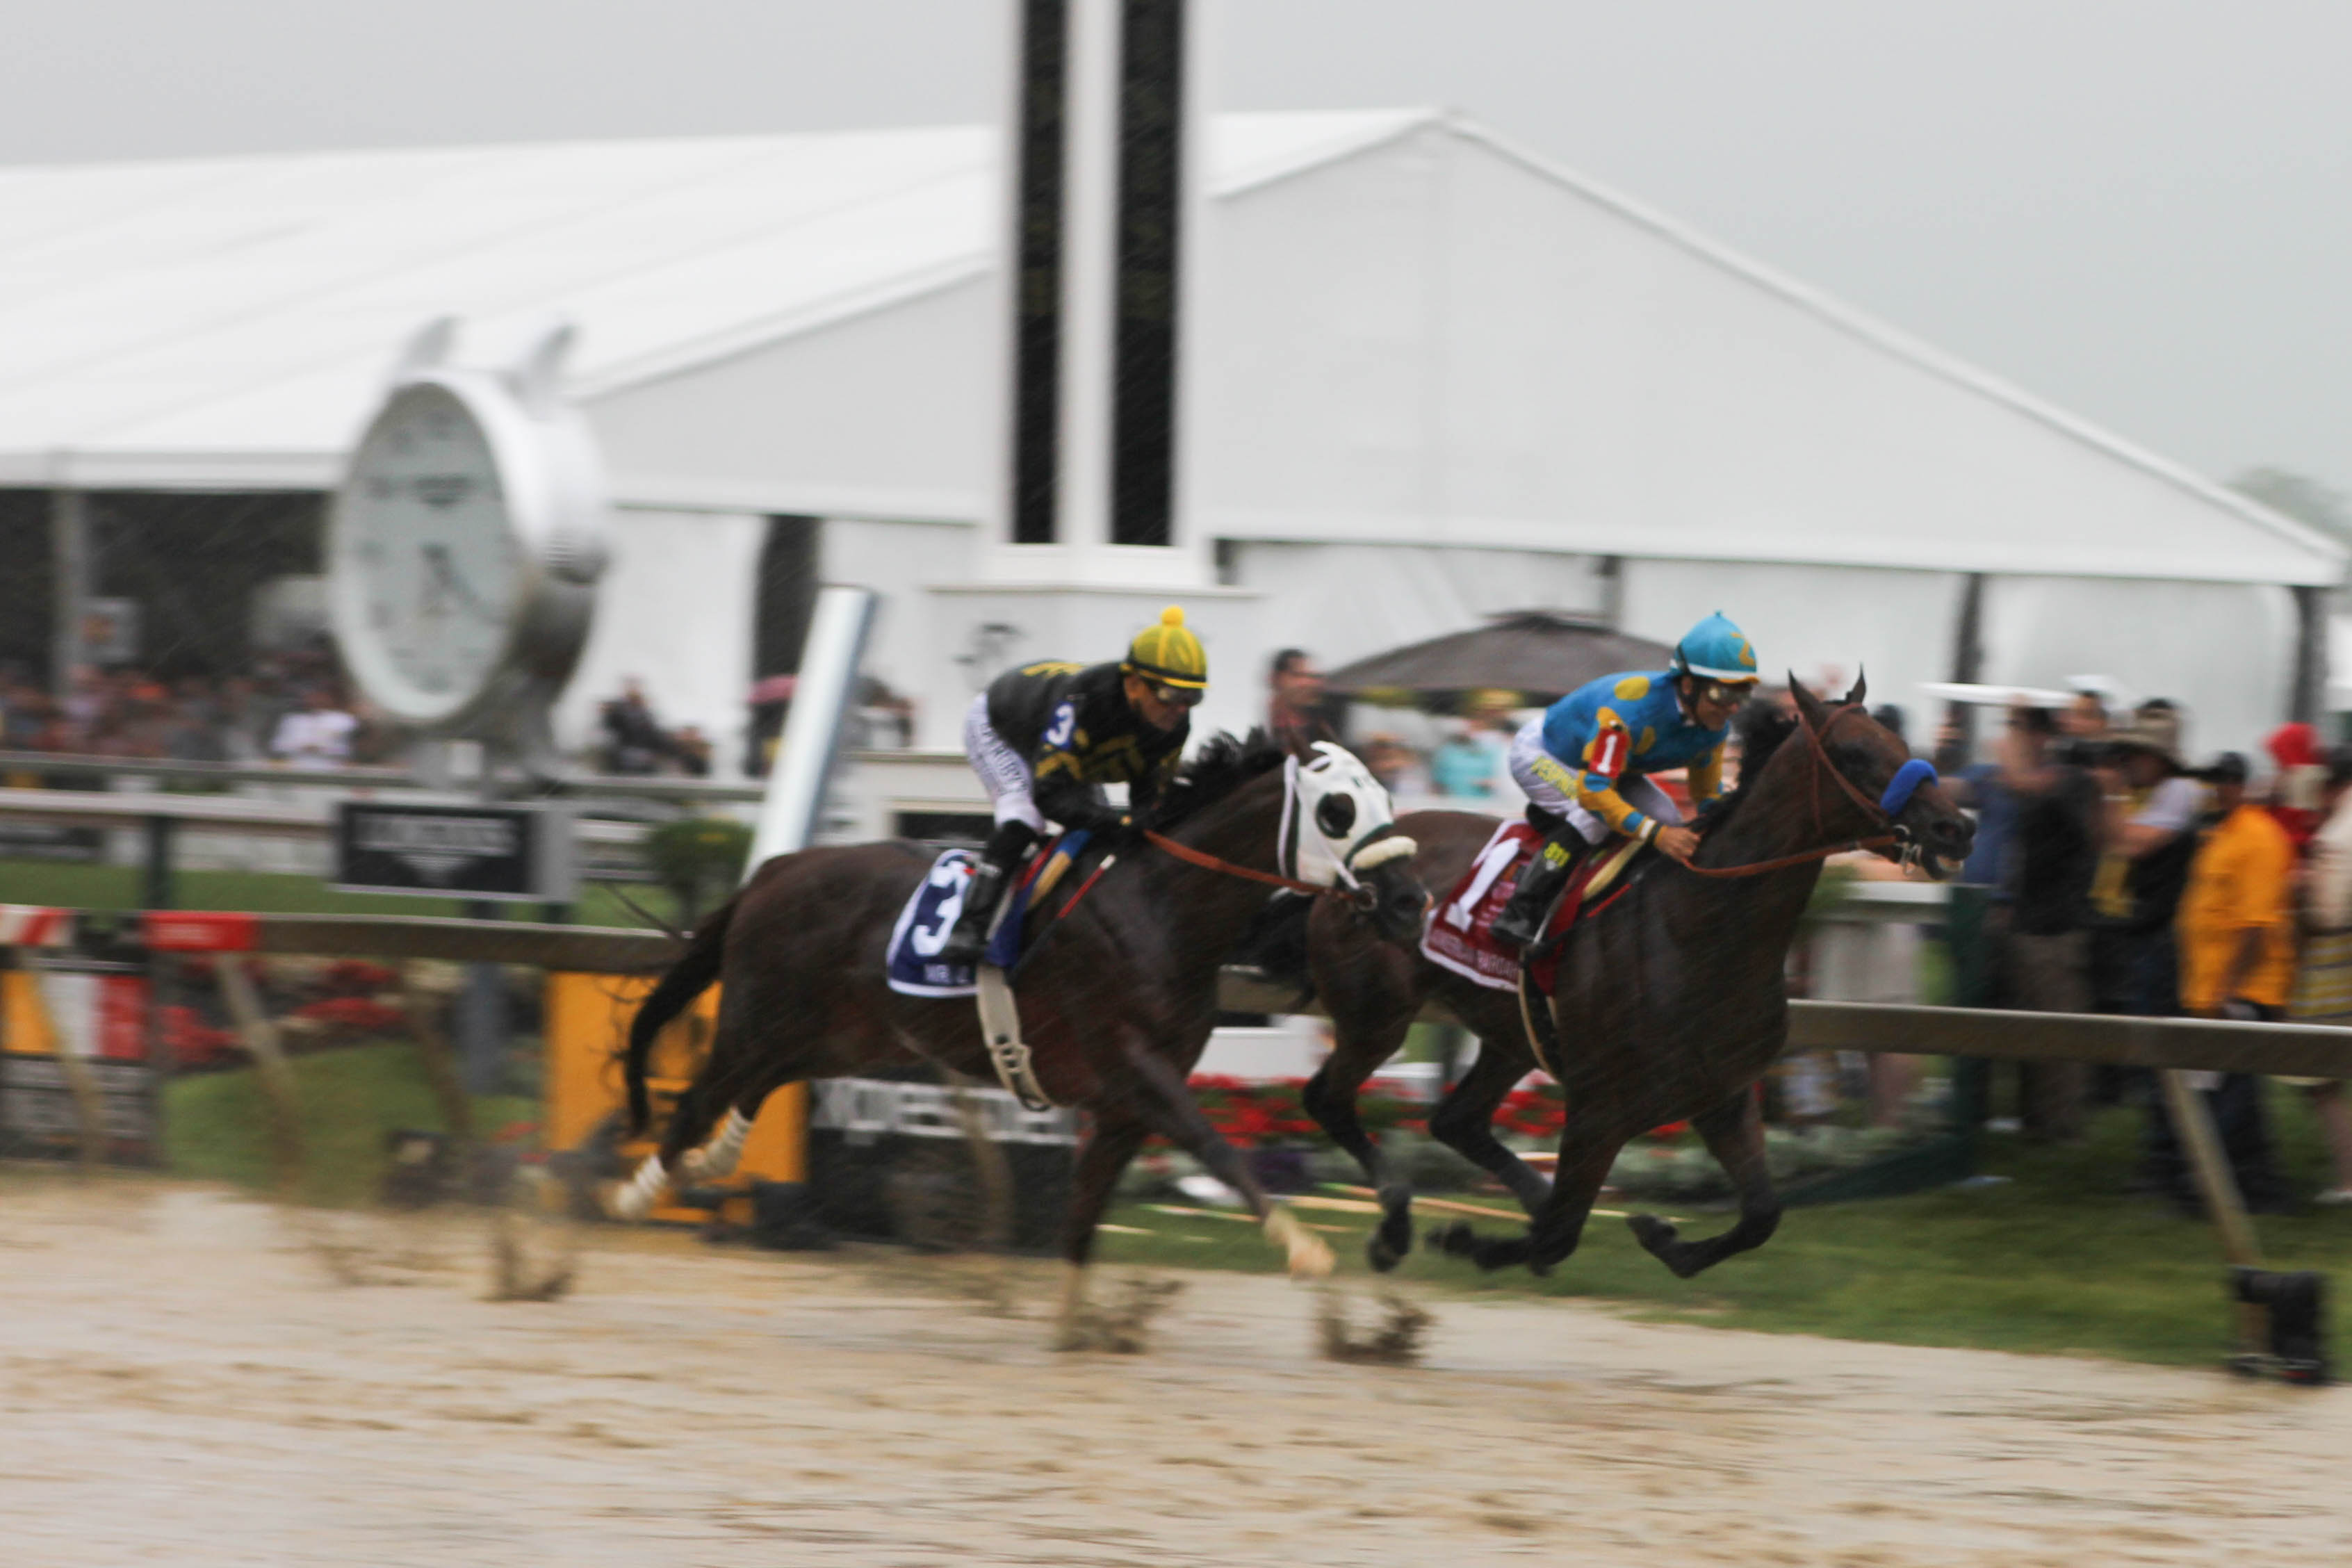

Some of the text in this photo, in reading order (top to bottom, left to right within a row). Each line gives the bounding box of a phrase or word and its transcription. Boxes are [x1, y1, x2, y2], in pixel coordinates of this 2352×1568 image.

[1047, 703, 1075, 746] 3
[1596, 734, 1617, 774] 1
[912, 860, 971, 956] 3
[1444, 837, 1522, 933] 1
